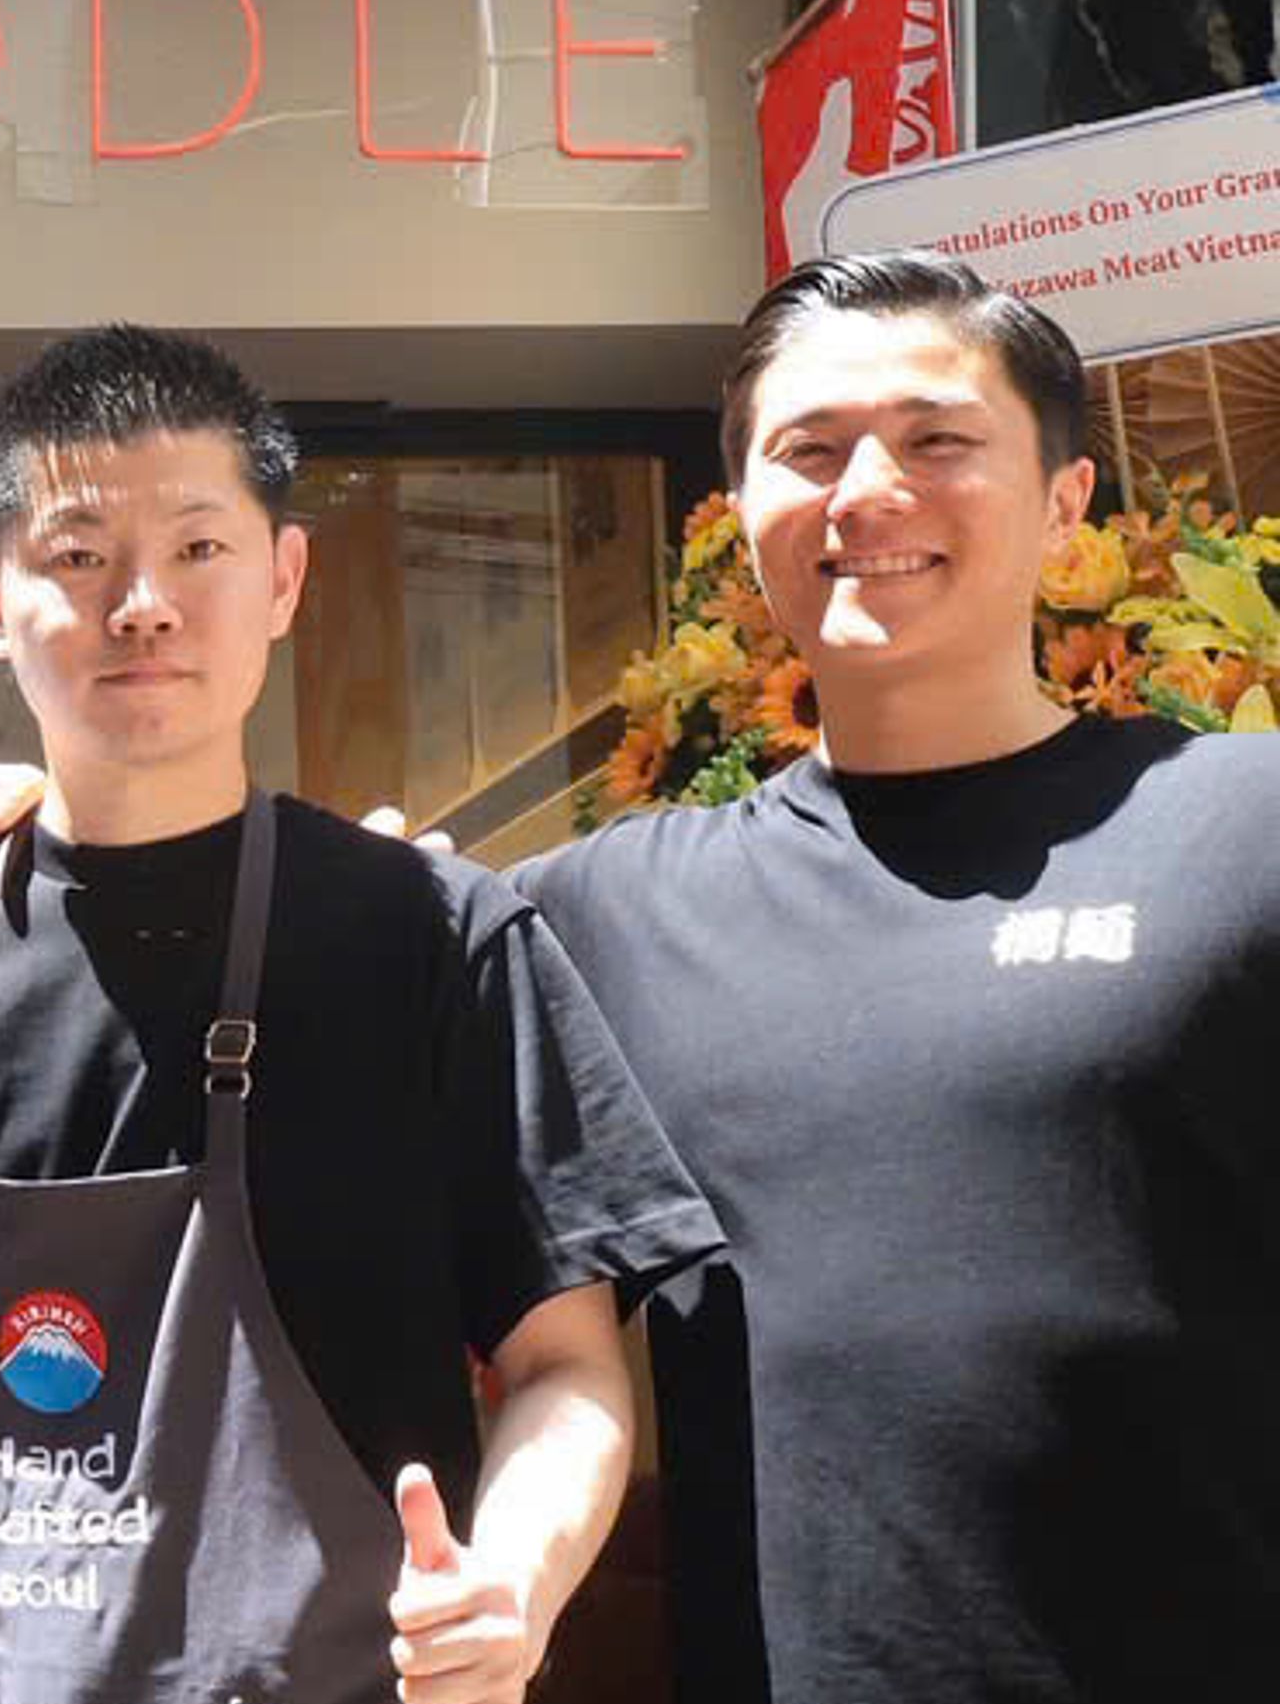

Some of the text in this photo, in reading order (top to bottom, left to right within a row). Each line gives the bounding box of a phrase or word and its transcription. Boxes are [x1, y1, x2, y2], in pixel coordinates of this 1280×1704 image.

[926, 209, 1083, 255] atulations
[1089, 197, 1130, 225] On
[1135, 182, 1208, 216] Your
[1103, 246, 1181, 284] Meat
